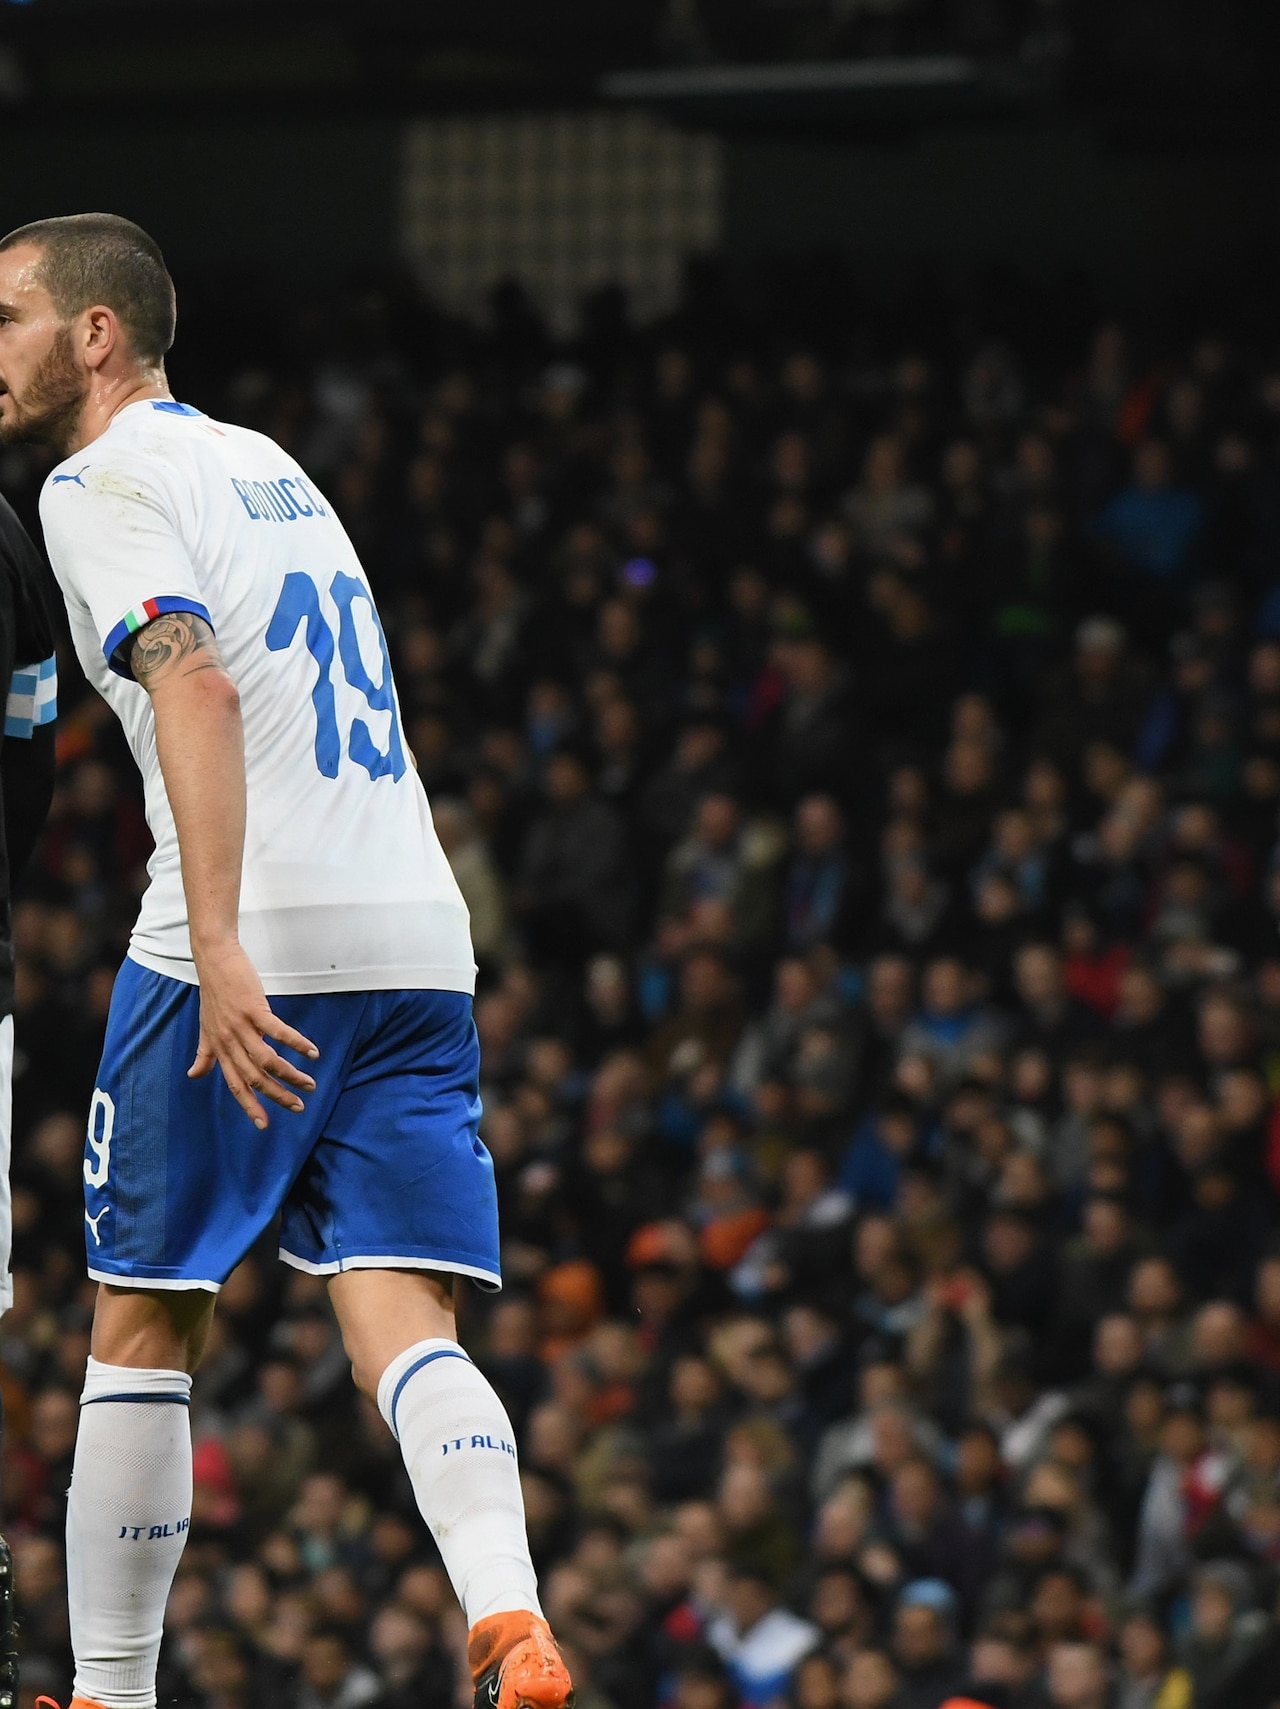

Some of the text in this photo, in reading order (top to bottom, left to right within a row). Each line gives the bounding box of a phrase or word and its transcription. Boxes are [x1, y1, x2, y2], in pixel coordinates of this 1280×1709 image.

[265, 570, 407, 784] 19
[441, 1434, 516, 1459] ITALIA
[118, 1517, 189, 1541] ITALIA
